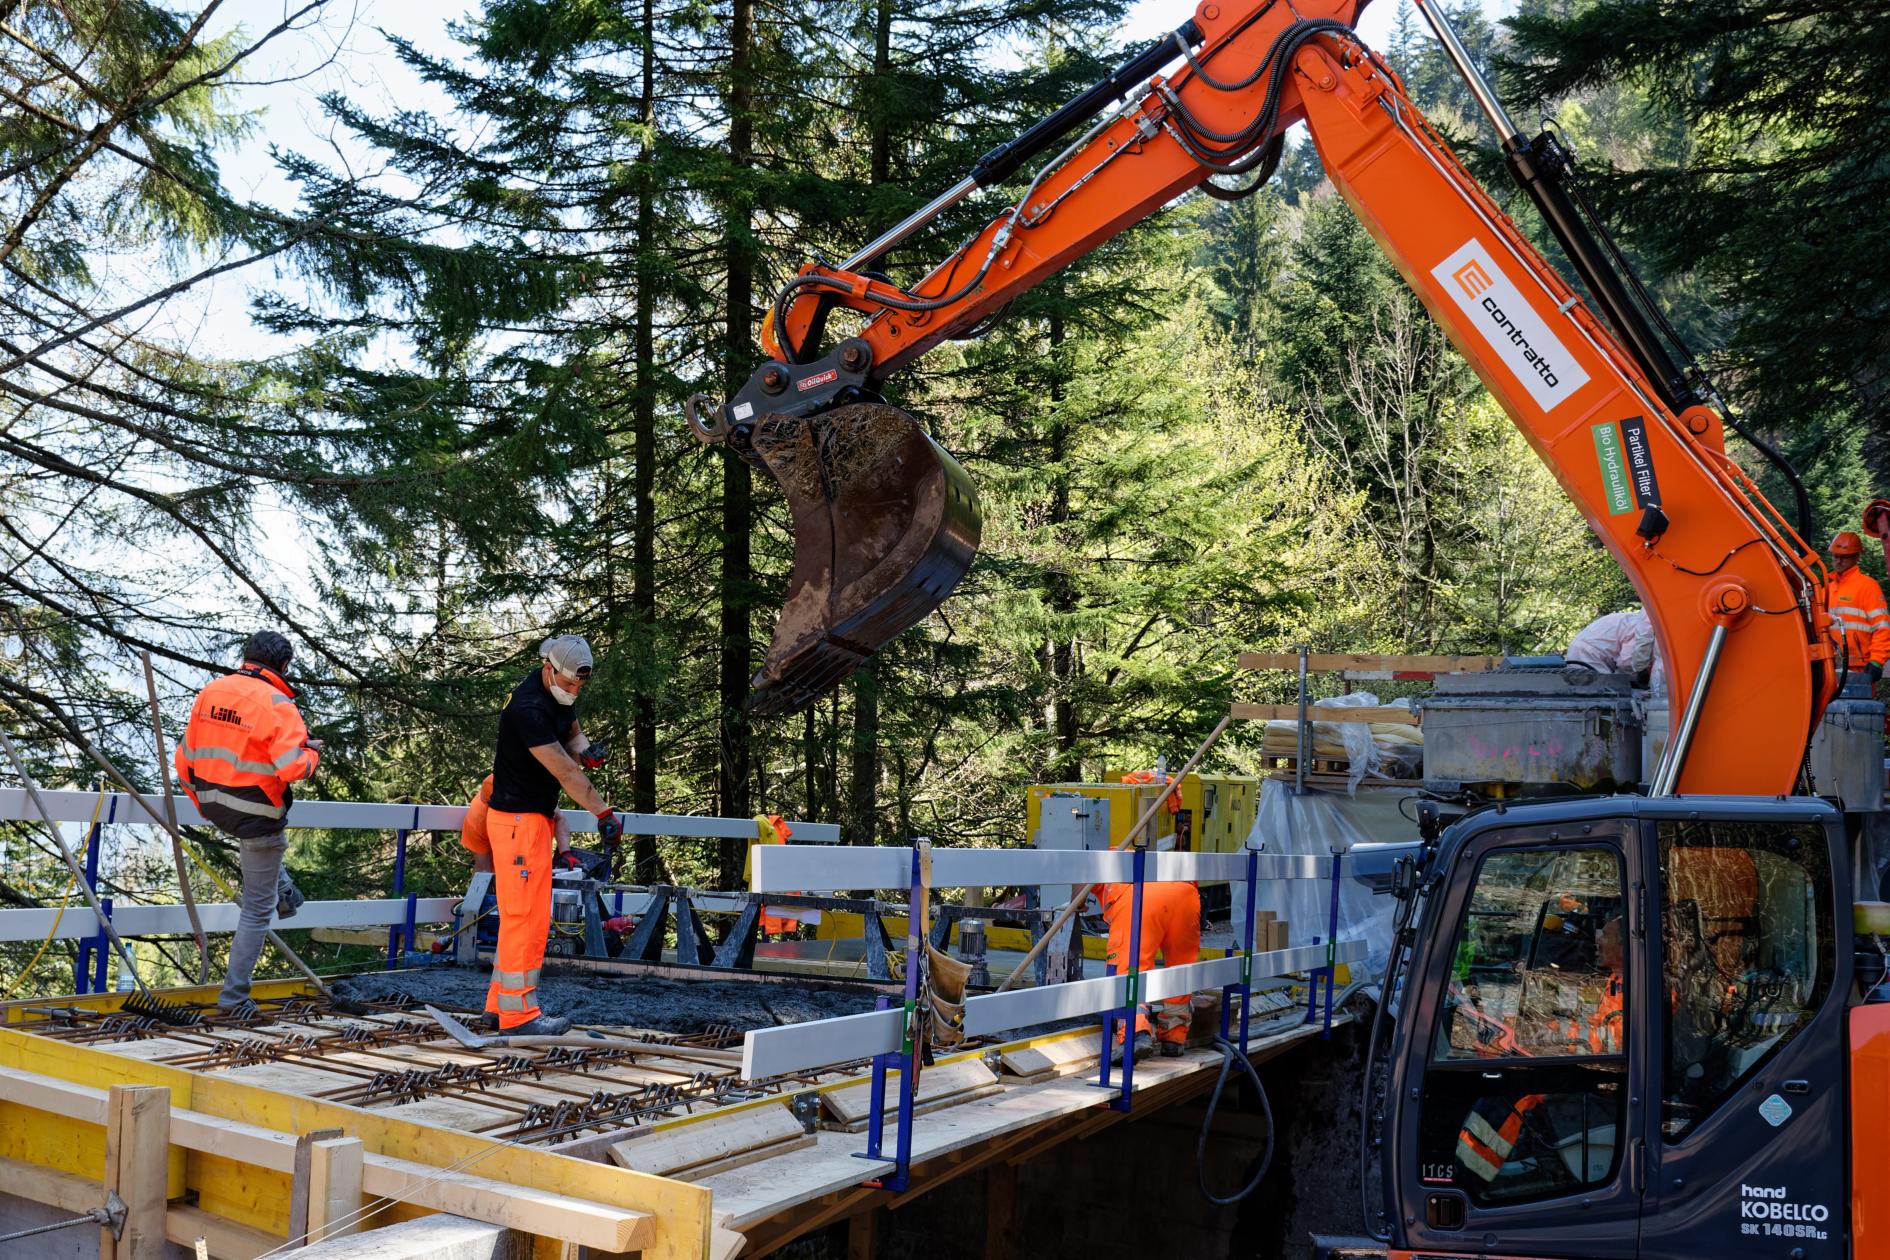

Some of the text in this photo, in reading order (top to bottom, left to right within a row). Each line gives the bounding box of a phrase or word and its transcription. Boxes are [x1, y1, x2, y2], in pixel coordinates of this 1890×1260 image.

[1481, 297, 1559, 388] contratto
[1600, 426, 1629, 511] Bio Hydrauliköl
[1627, 427, 1652, 496] Partikel Filter
[1741, 1184, 1786, 1199] hand
[1741, 1201, 1829, 1222] KOBELCO
[1741, 1223, 1760, 1235] SK
